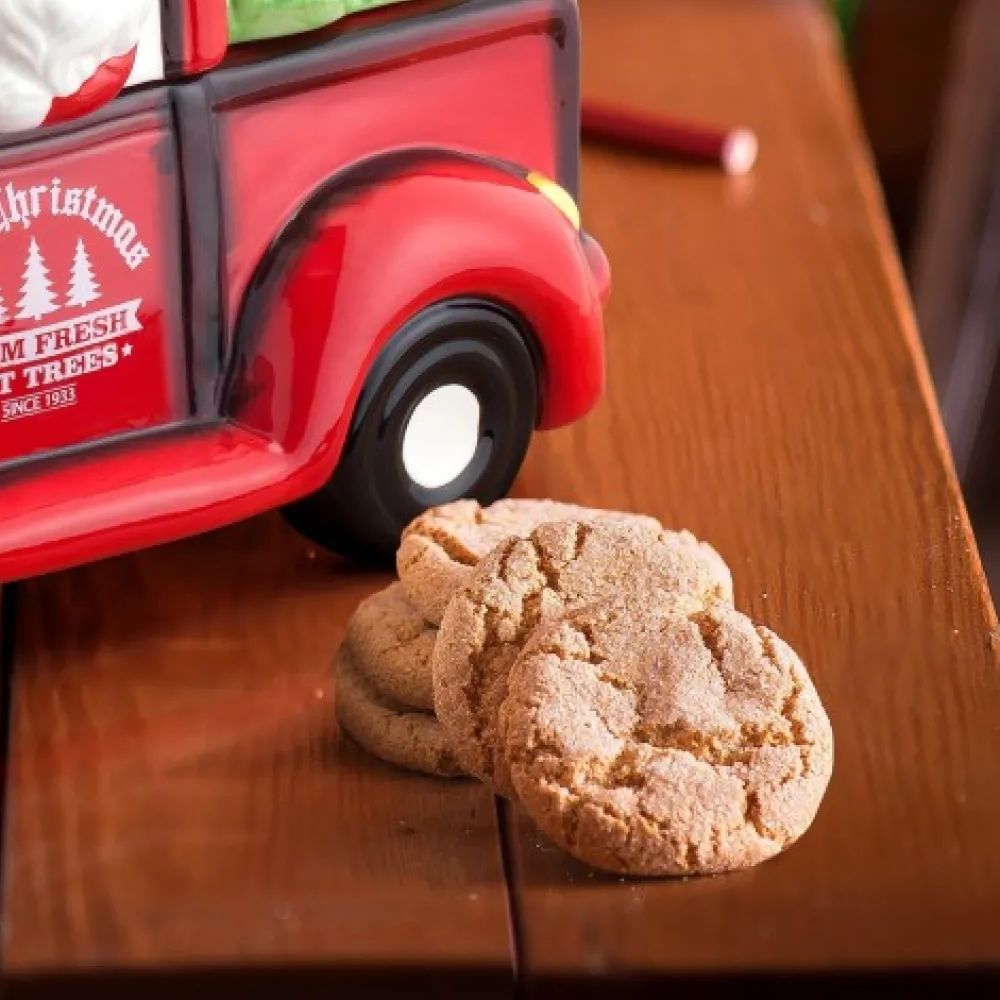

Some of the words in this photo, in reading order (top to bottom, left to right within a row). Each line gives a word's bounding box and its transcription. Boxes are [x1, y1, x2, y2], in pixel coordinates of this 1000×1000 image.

[34, 308, 129, 356] FRESH
[22, 342, 119, 388] TREES
[2, 395, 41, 419] SINCE
